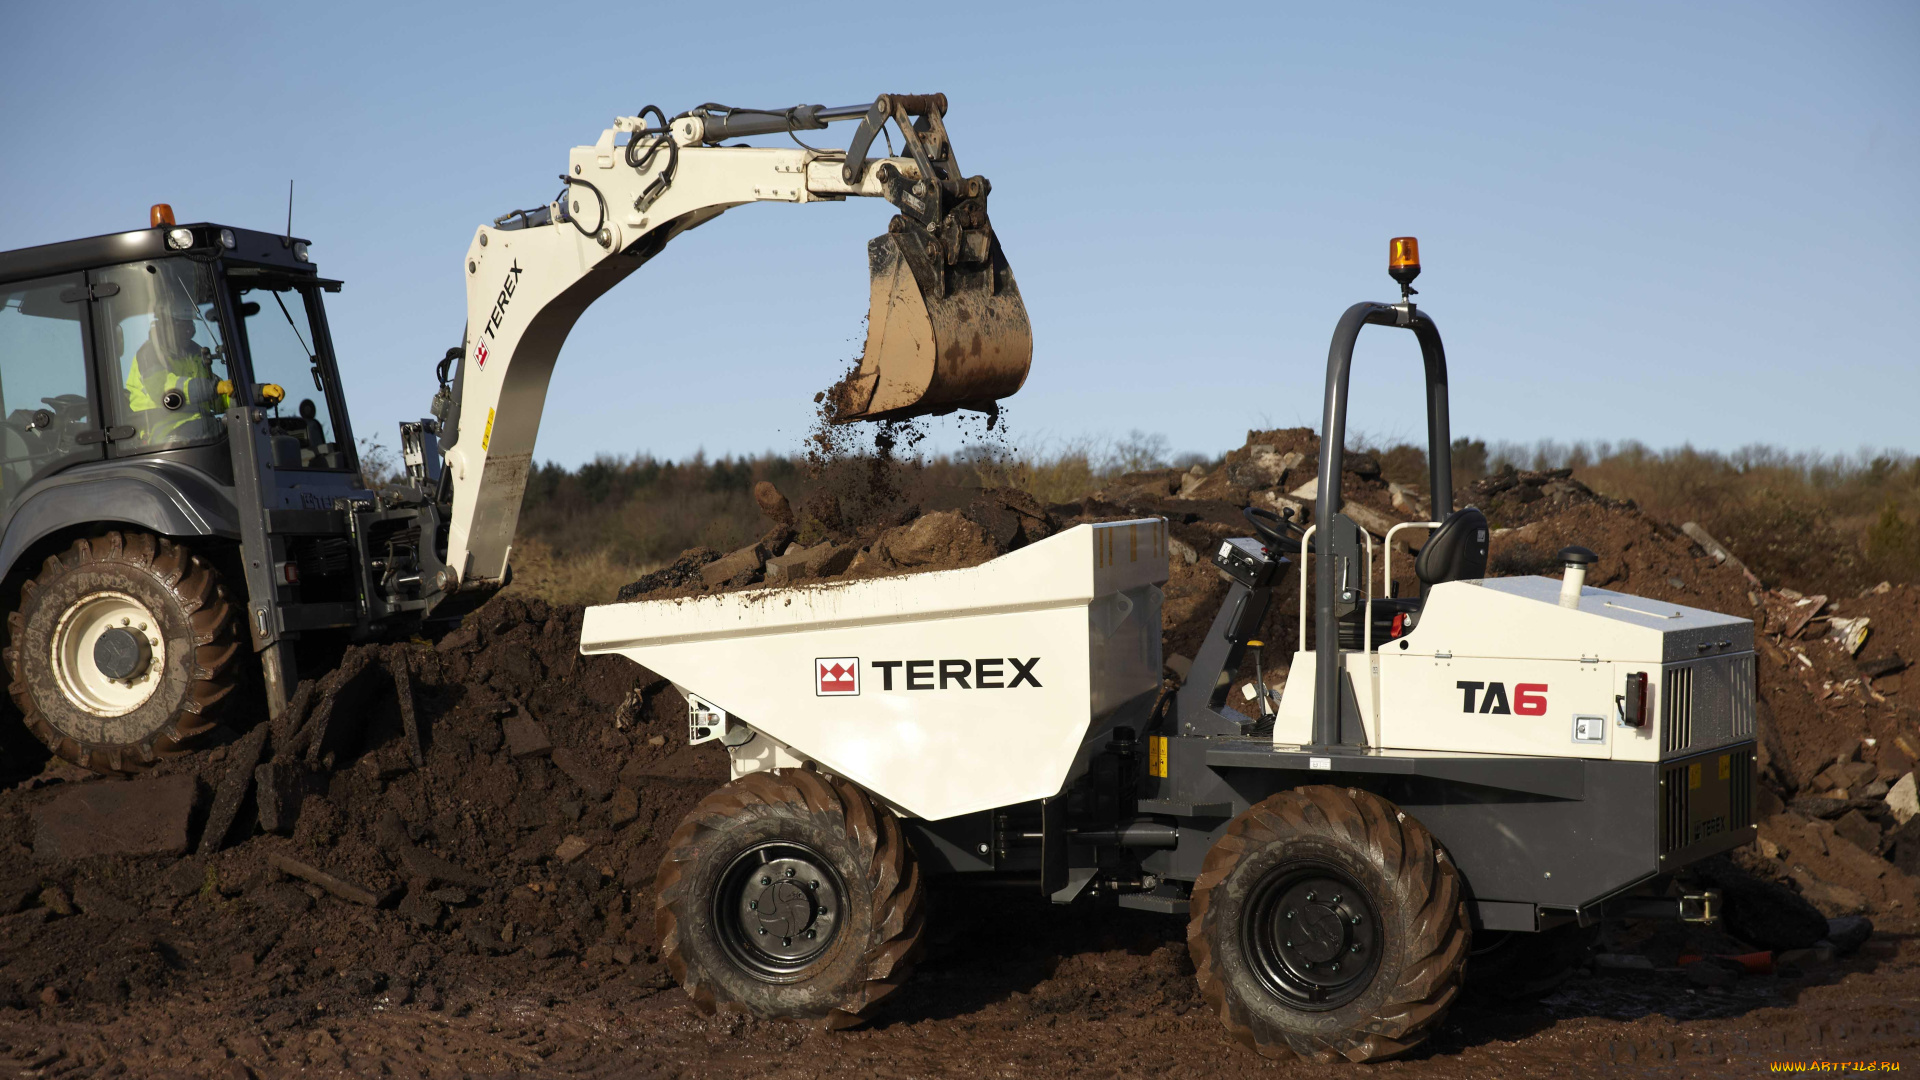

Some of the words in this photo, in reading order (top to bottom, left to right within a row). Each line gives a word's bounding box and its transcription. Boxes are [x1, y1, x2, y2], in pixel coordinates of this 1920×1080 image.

[484, 257, 523, 340] TEREX
[871, 657, 1043, 691] TEREX
[1456, 680, 1549, 717] TA6
[1702, 815, 1726, 839] TEREX
